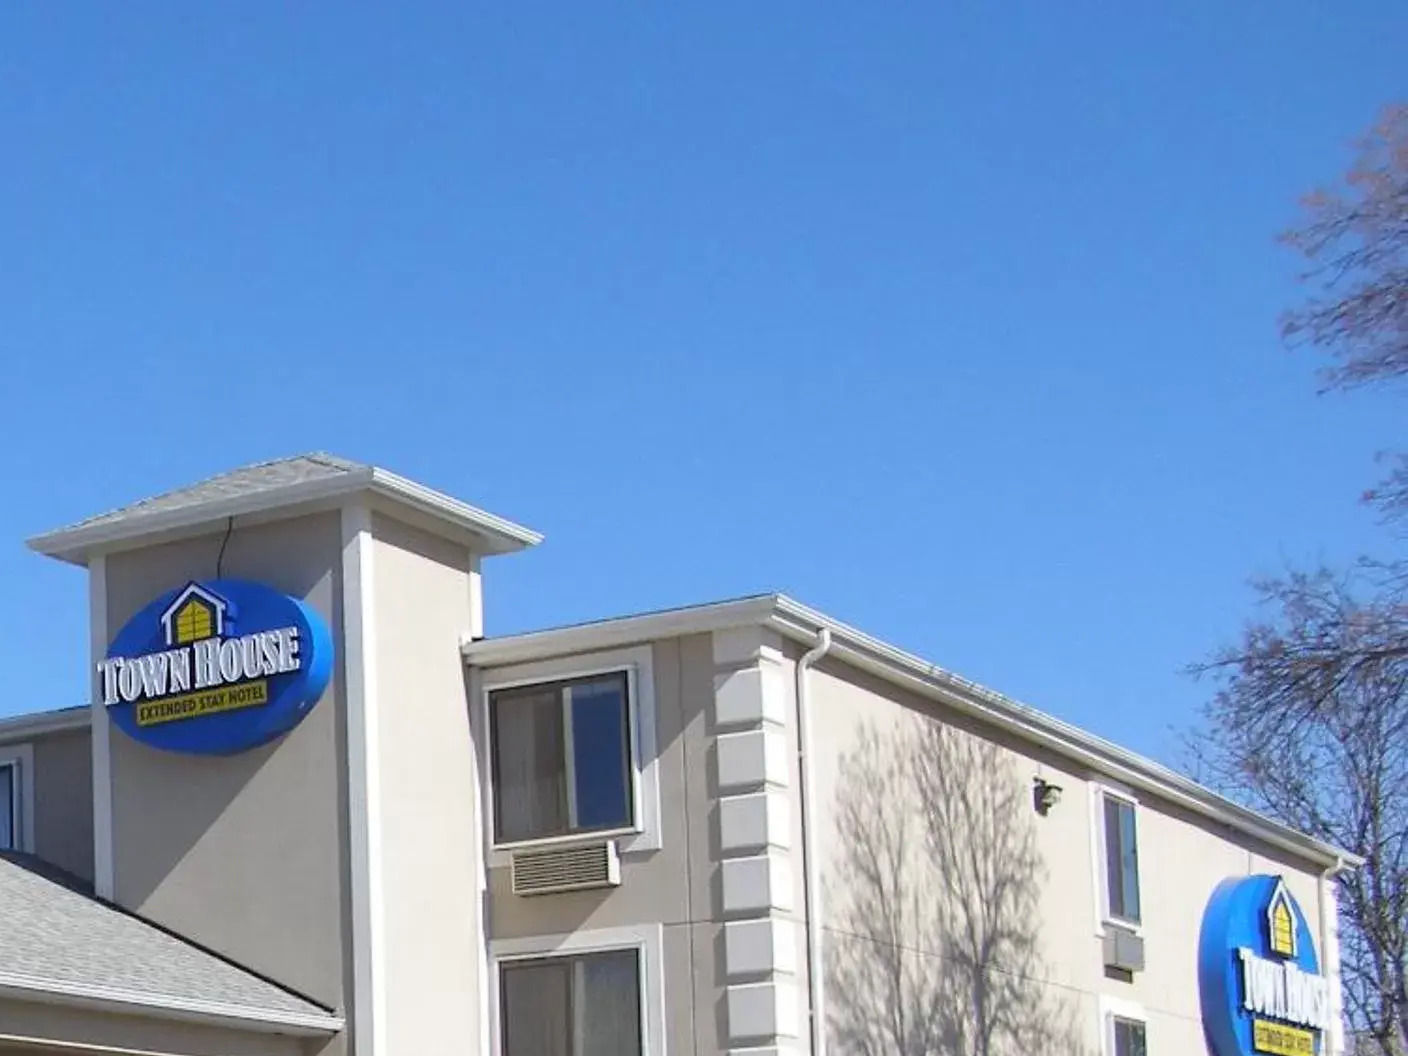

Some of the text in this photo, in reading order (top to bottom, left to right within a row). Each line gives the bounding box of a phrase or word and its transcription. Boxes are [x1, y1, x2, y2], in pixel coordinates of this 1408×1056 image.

[97, 627, 300, 705] TOWN HOUSE
[140, 686, 265, 721] EXTENDED STAY HOTEL
